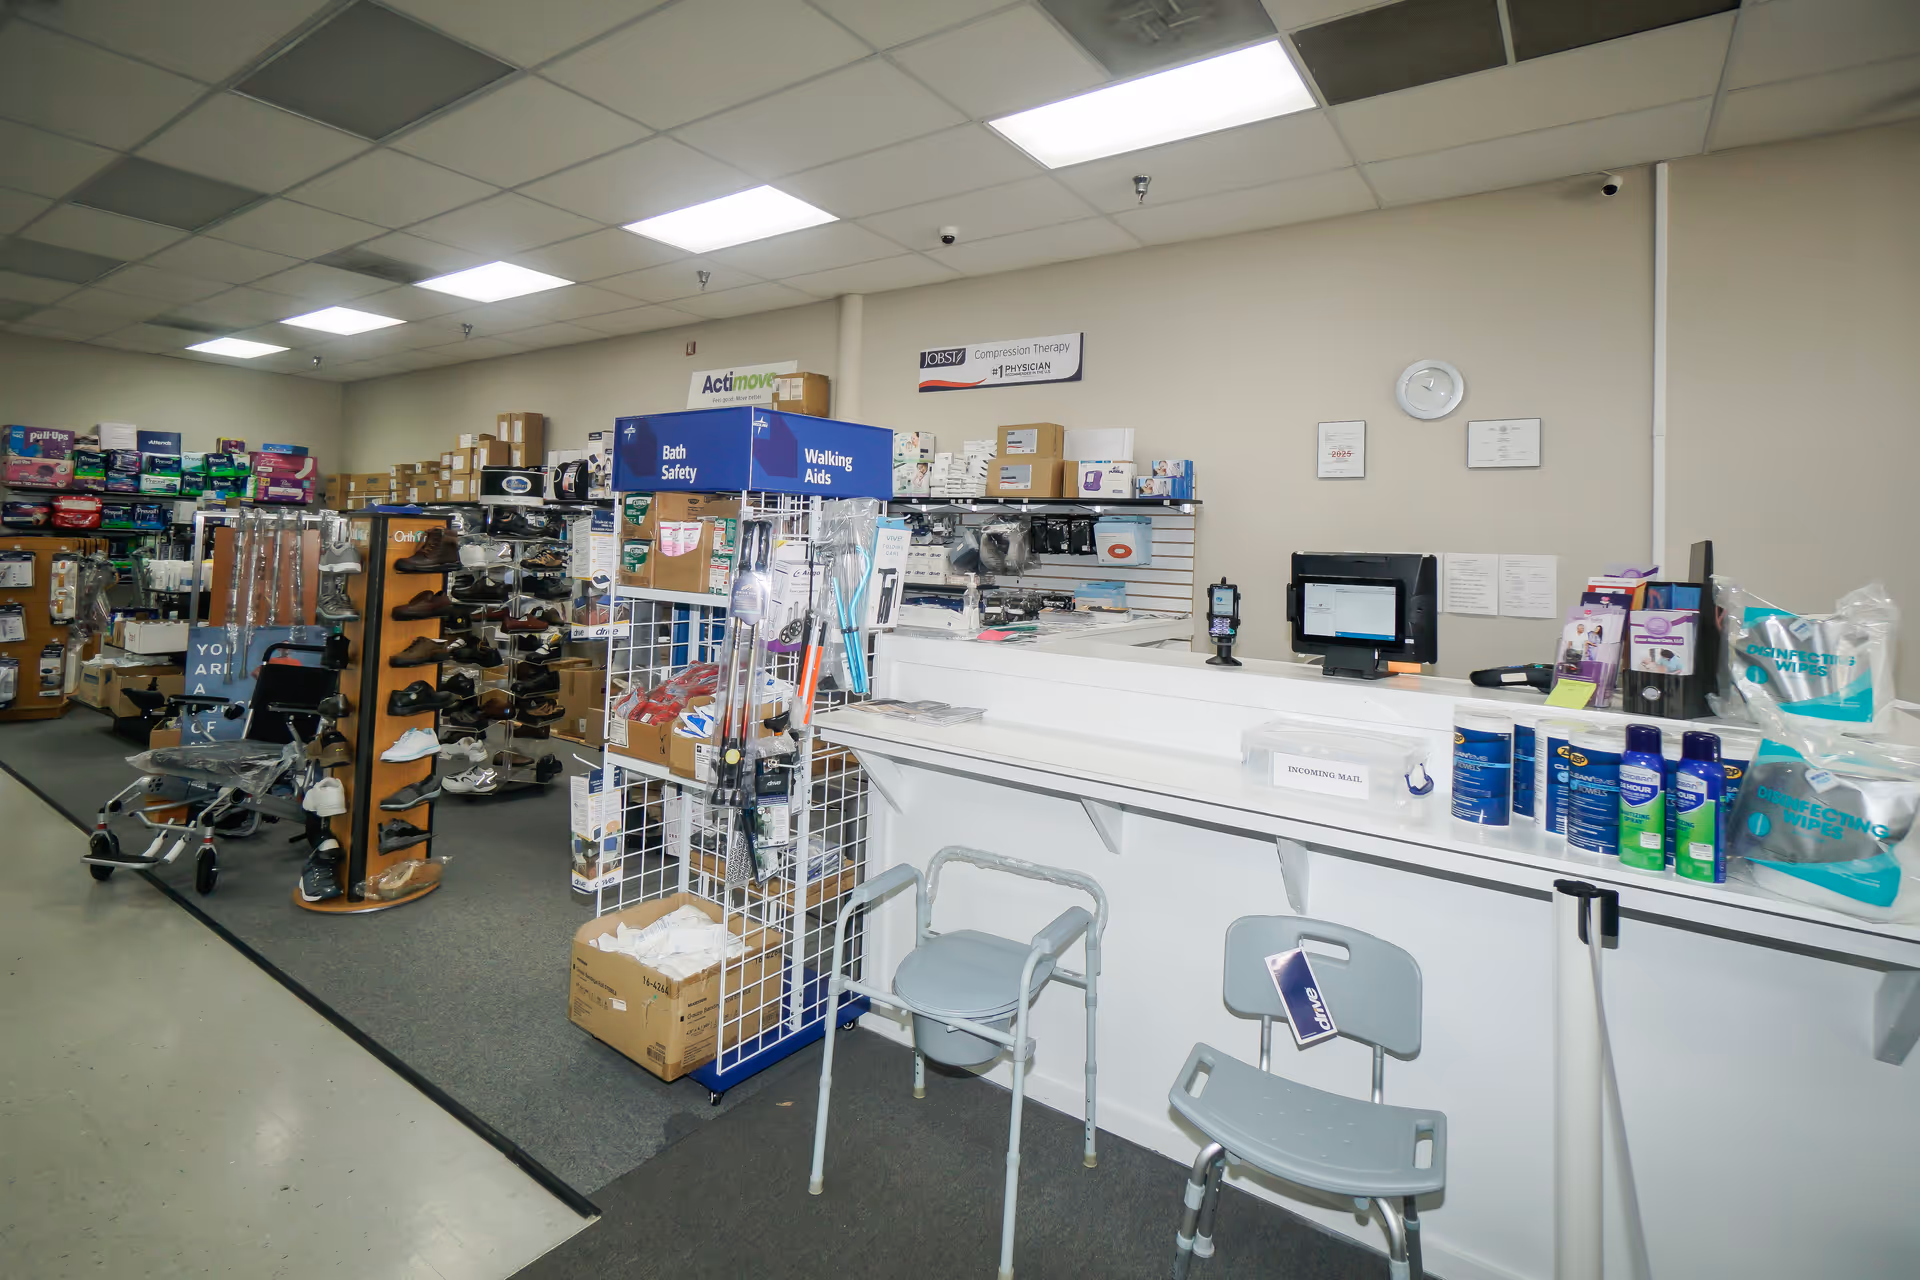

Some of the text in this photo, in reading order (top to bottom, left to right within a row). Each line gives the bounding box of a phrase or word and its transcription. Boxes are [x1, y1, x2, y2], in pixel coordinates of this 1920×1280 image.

[924, 350, 957, 368] JOBST
[974, 342, 1070, 359] Compression Therapy
[992, 361, 1051, 378] #1 PHYSICIAN
[702, 371, 776, 394] Actimove
[662, 443, 686, 460] Bath
[804, 448, 853, 472] Walking
[1332, 450, 1352, 458] 2025
[661, 464, 697, 484] Safety
[804, 468, 832, 485] Aids
[1775, 660, 1828, 677] WIPES
[193, 683, 205, 694] A
[1288, 765, 1362, 783] INCOMING MAIL
[1626, 784, 1652, 794] HOUR
[1677, 792, 1697, 801] OUR
[1757, 785, 1889, 838] DISINFECTING
[1783, 809, 1844, 840] WIPES
[643, 975, 669, 996] 16-4264
[1305, 987, 1331, 1030] drive
